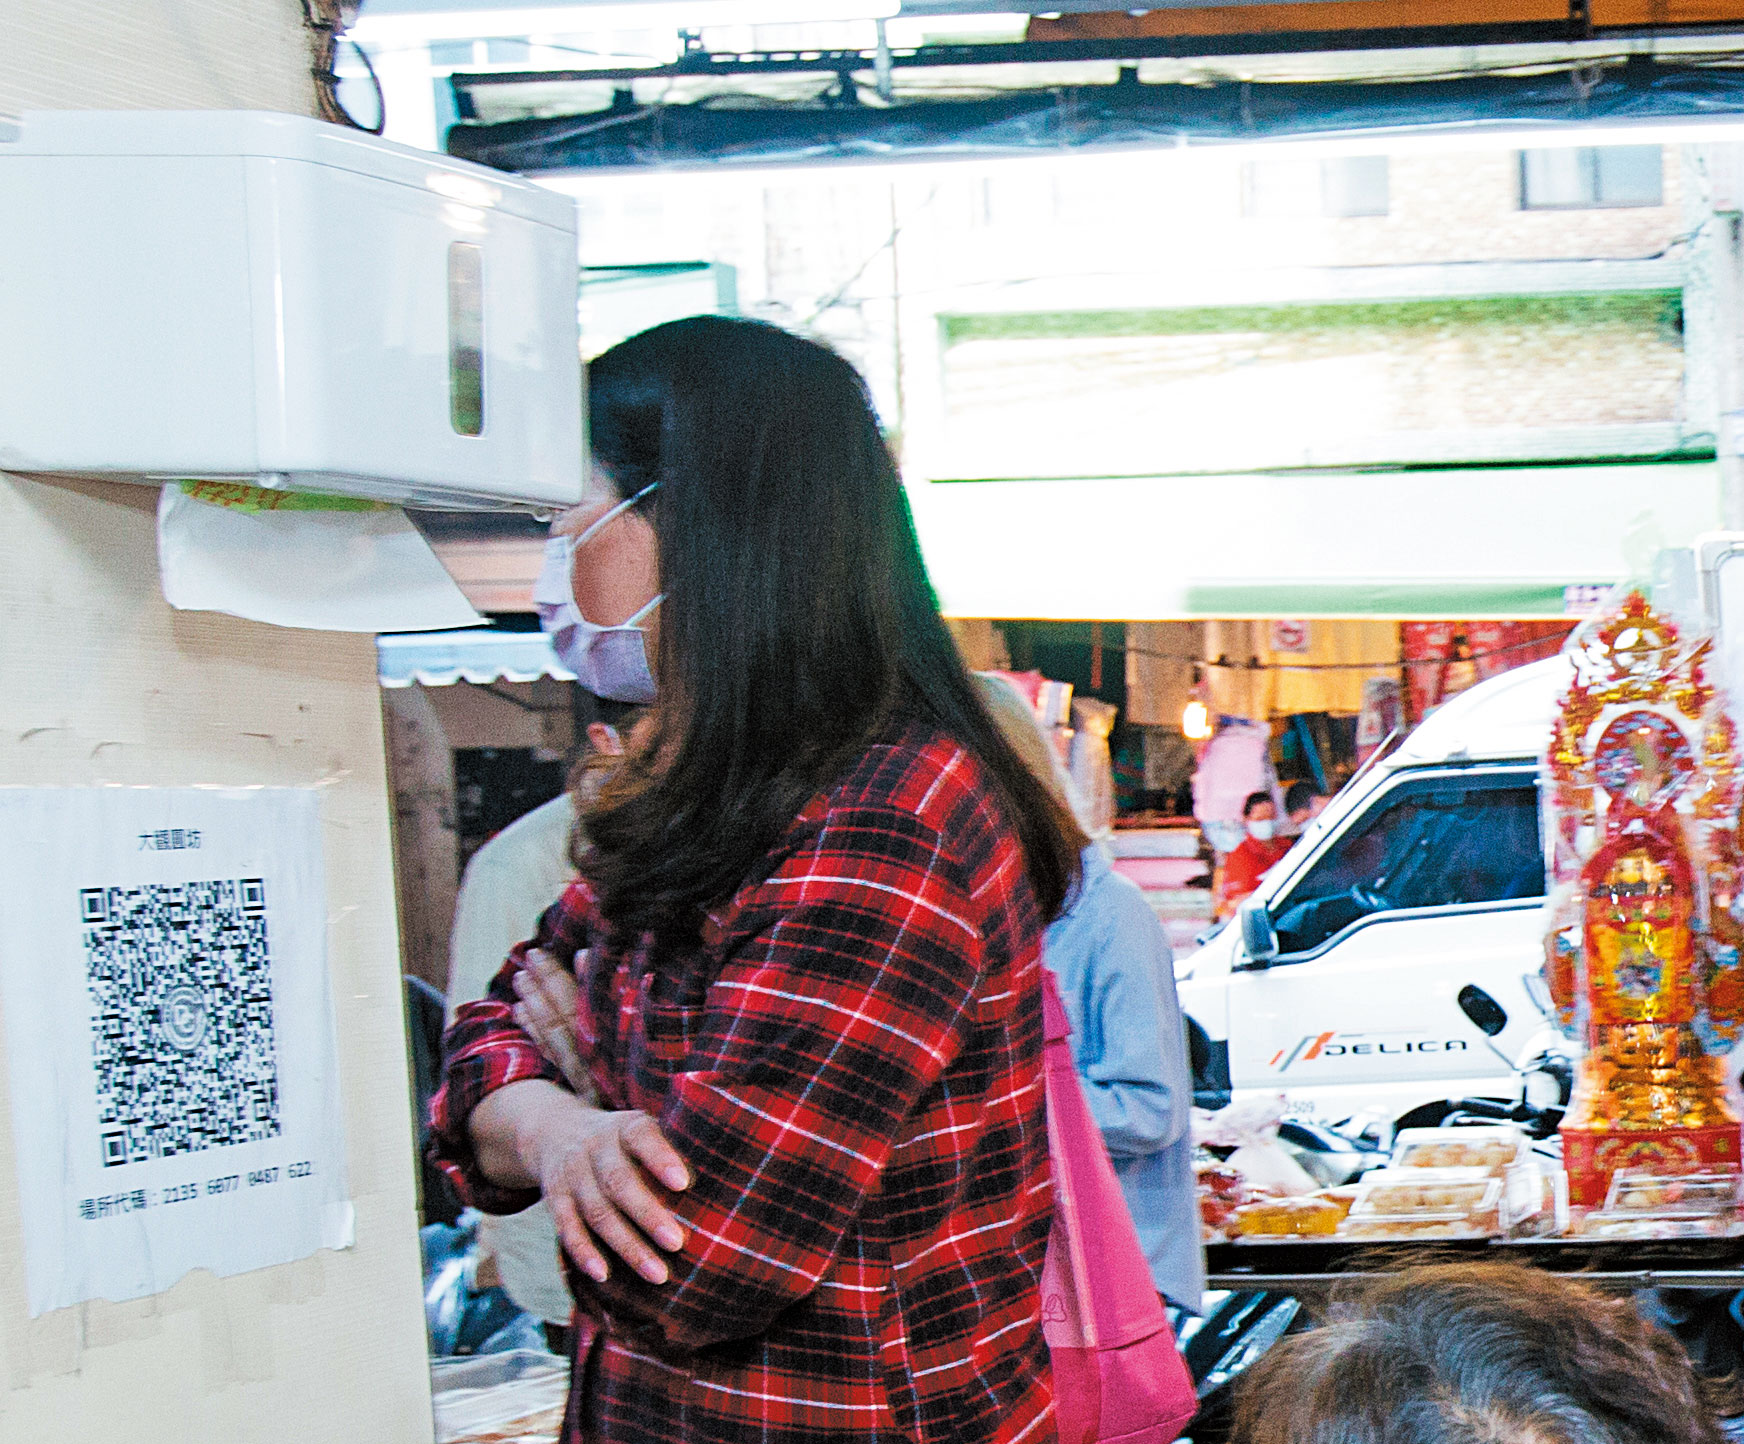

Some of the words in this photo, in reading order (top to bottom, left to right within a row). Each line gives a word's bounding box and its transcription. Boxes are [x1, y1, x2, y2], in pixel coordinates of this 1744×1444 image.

[1324, 1039, 1467, 1057] DELICA
[162, 1182, 198, 1205] 2135
[287, 1160, 313, 1179] 622
